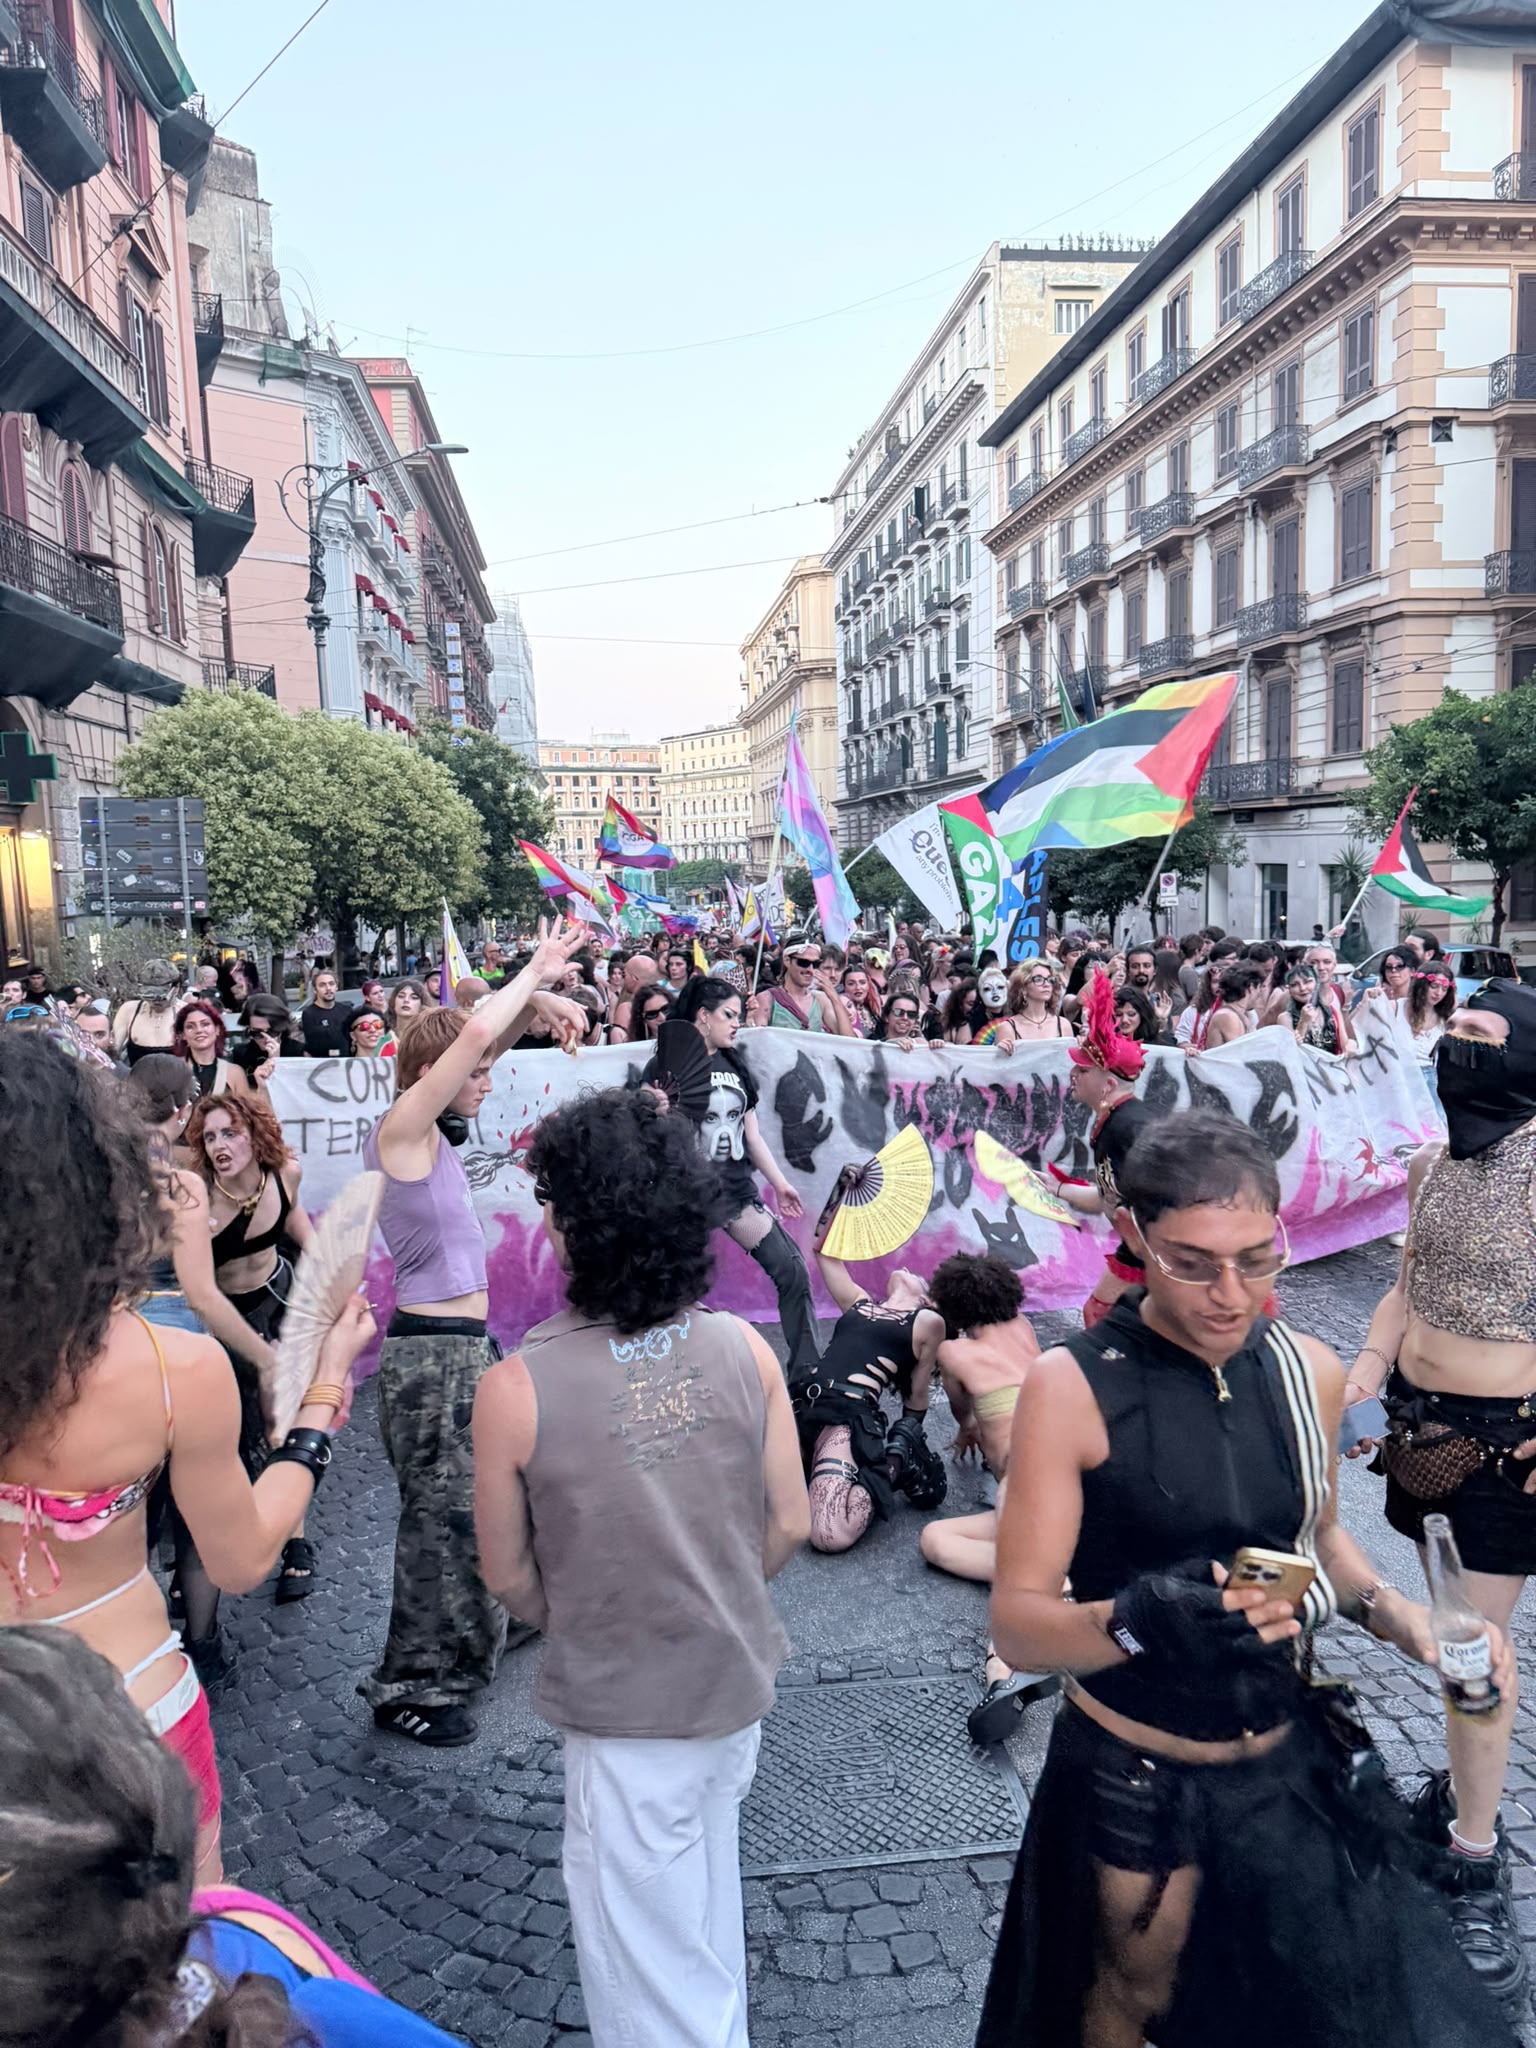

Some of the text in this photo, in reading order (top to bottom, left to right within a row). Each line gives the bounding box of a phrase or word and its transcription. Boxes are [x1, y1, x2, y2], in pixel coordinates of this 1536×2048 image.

[916, 855, 928, 870] any
[960, 841, 997, 950] GAZ
[1010, 850, 1048, 962] APLES
[307, 1058, 398, 1104] COR
